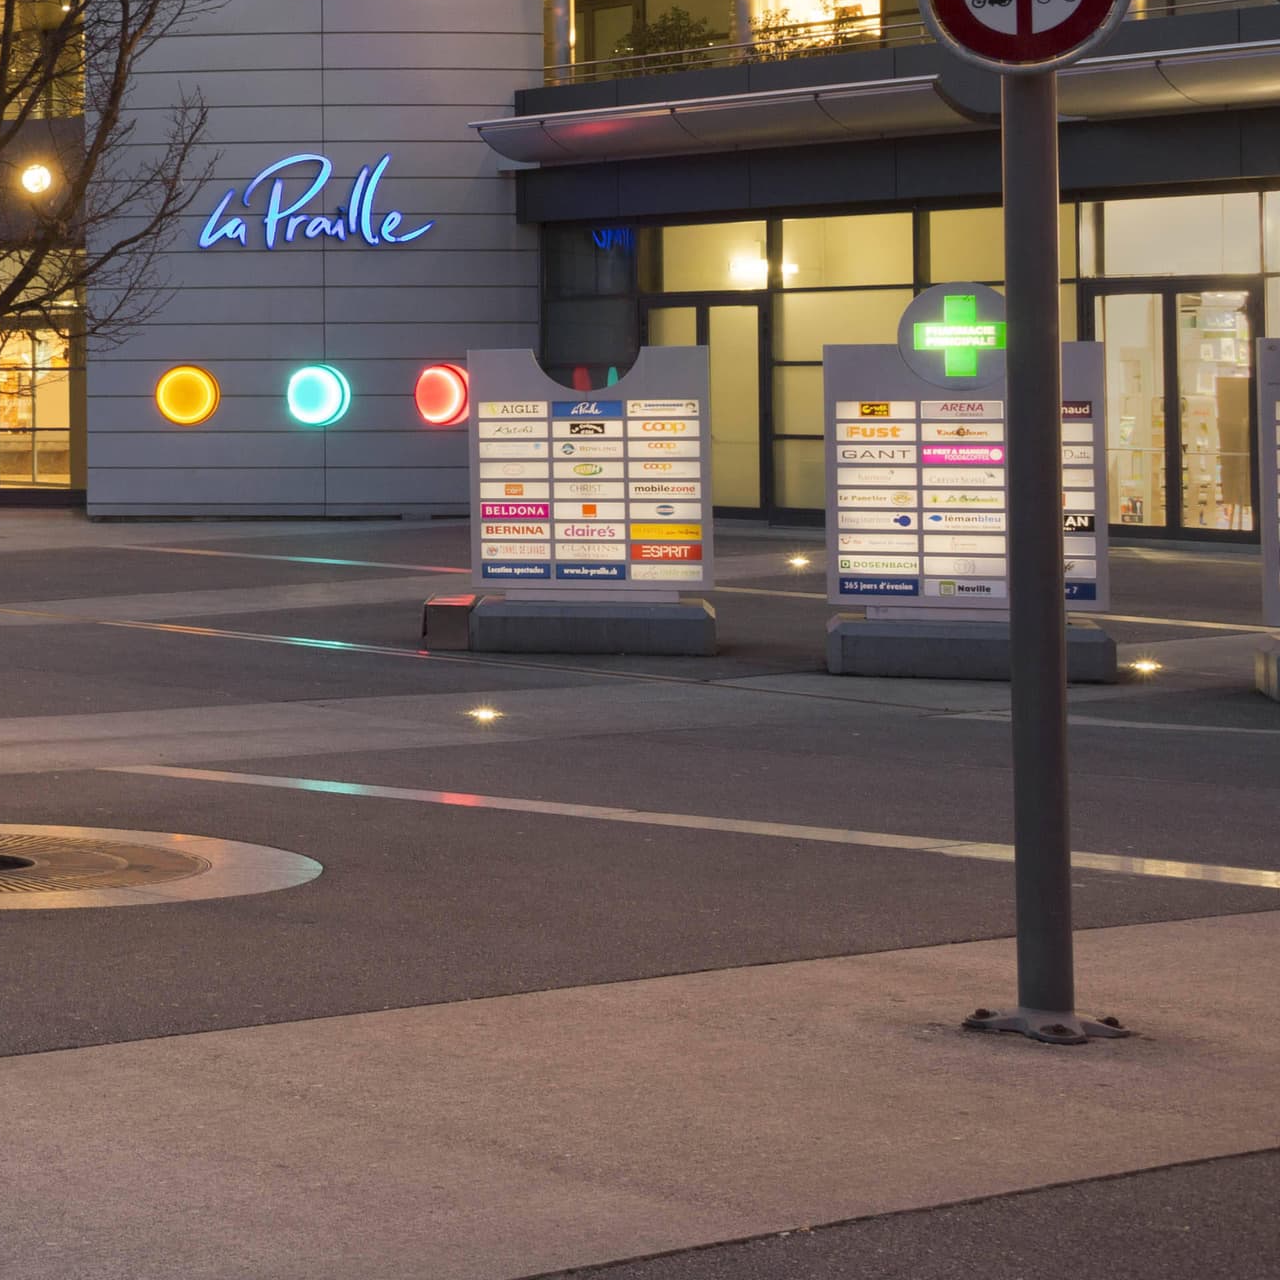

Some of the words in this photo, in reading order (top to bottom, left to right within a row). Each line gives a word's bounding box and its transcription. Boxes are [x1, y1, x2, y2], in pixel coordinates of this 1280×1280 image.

[197, 187, 248, 250] La
[242, 152, 436, 251] Praille
[500, 404, 540, 415] AIGLE
[940, 402, 985, 412] ARENA
[642, 421, 687, 434] coop
[647, 442, 677, 450] coop
[842, 449, 911, 460] GANT
[643, 463, 673, 471] coop
[569, 483, 602, 493] CHRIST
[634, 483, 696, 494] mobilezone
[485, 505, 545, 516] BELDONA
[485, 525, 545, 535] BERNINA
[564, 524, 616, 538] claire's
[641, 544, 691, 558] ESPRIT
[853, 560, 918, 569] DOSENBACH
[844, 581, 859, 590] 365
[957, 585, 992, 593] Naville
